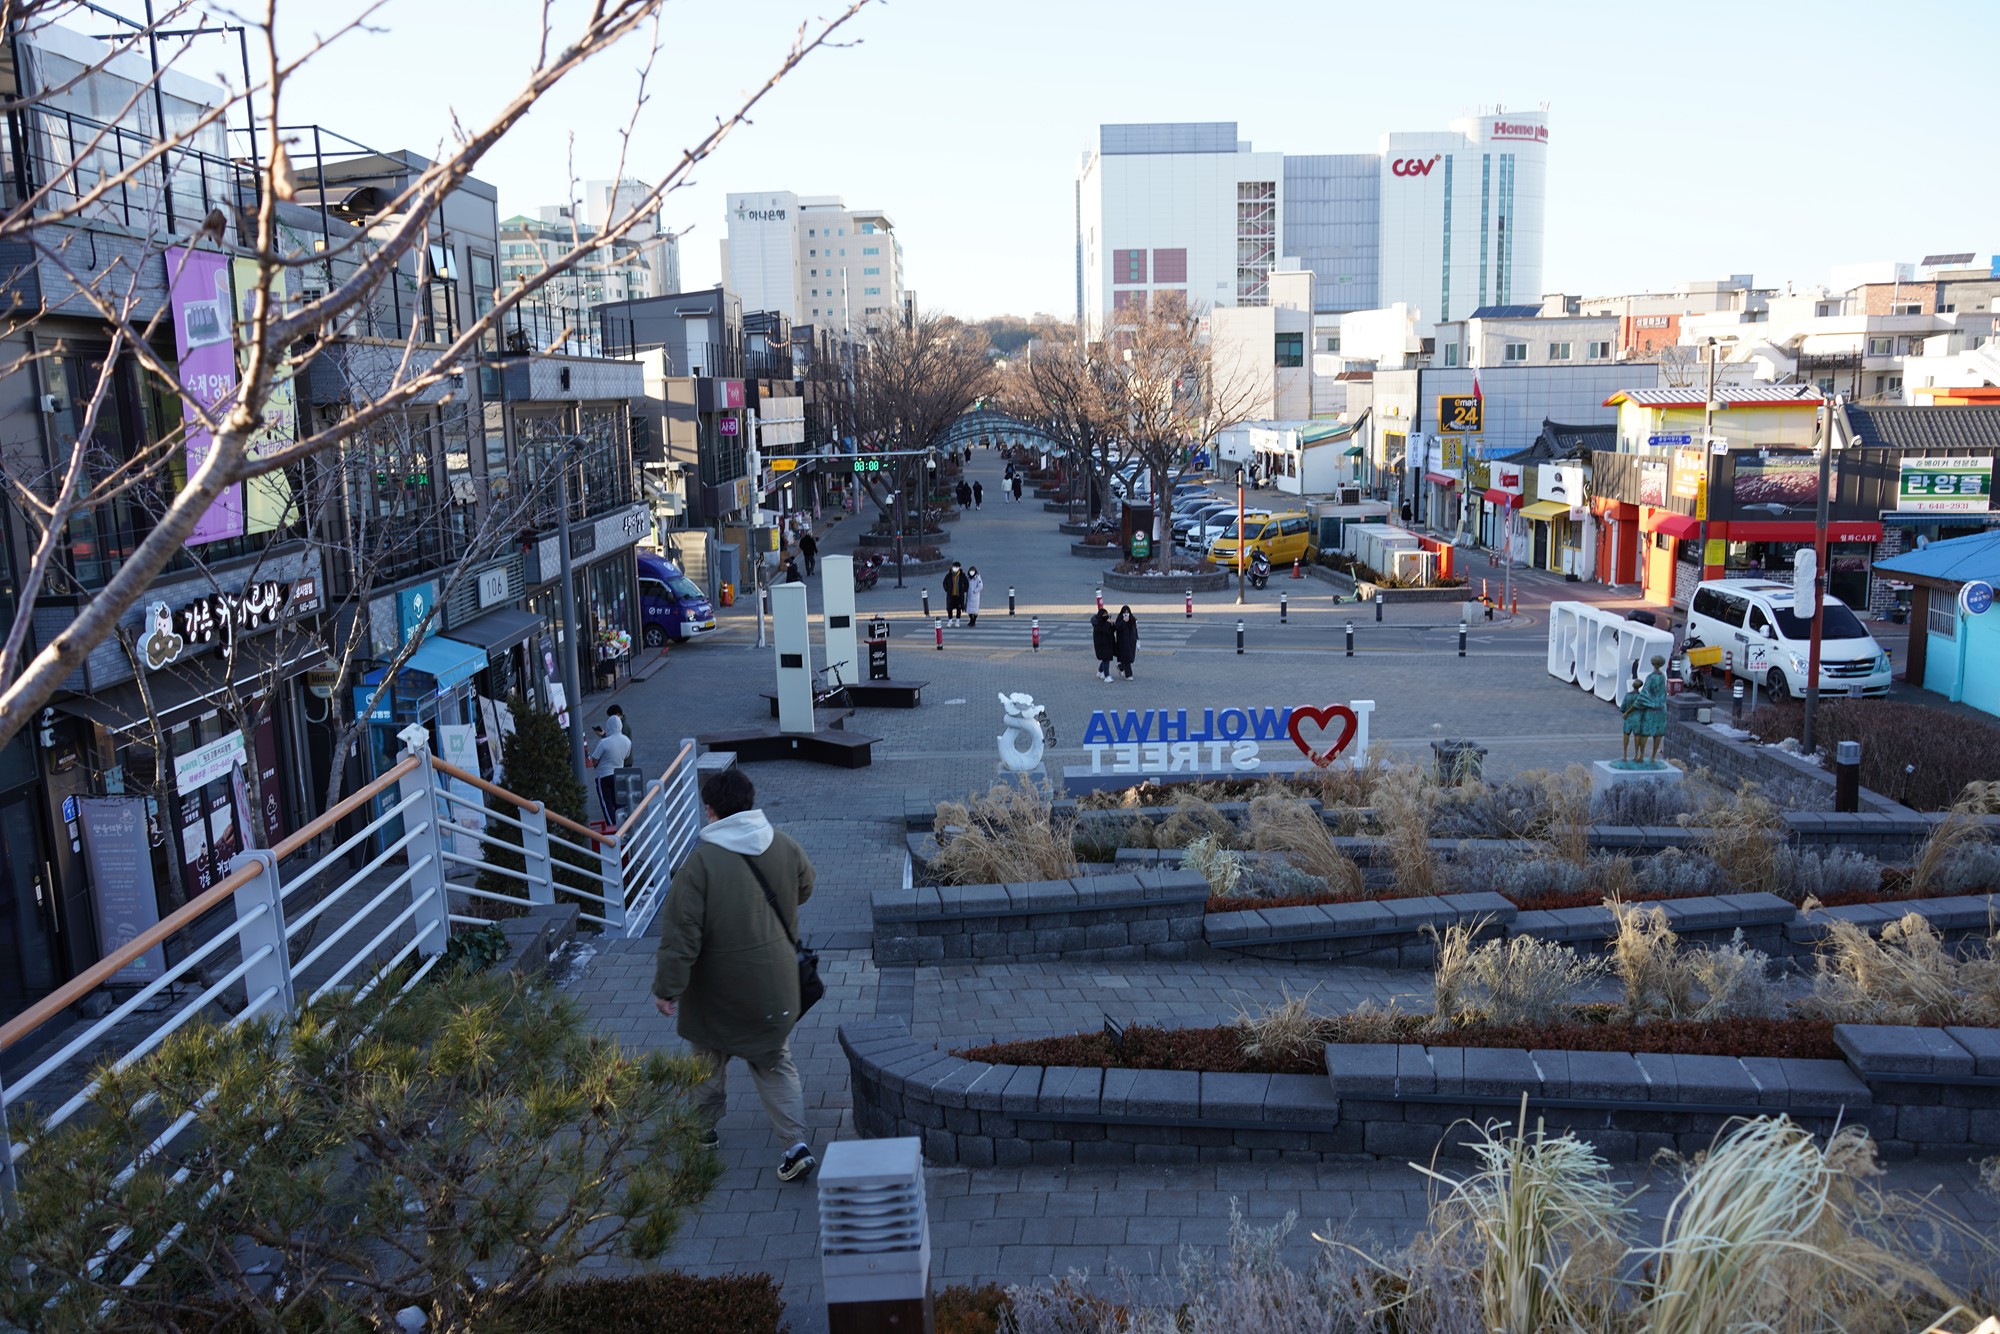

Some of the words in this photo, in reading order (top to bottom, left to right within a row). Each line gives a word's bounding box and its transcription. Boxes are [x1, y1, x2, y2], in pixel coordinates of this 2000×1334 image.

[1494, 121, 1534, 135] Home
[1392, 158, 1434, 177] CGV
[748, 209, 786, 221] 하나은행
[1454, 398, 1478, 407] emart
[1453, 407, 1479, 424] 24
[721, 421, 736, 432] 사주
[1907, 474, 1983, 494] 란양품
[486, 576, 503, 599] 106
[184, 600, 214, 643] 강릉
